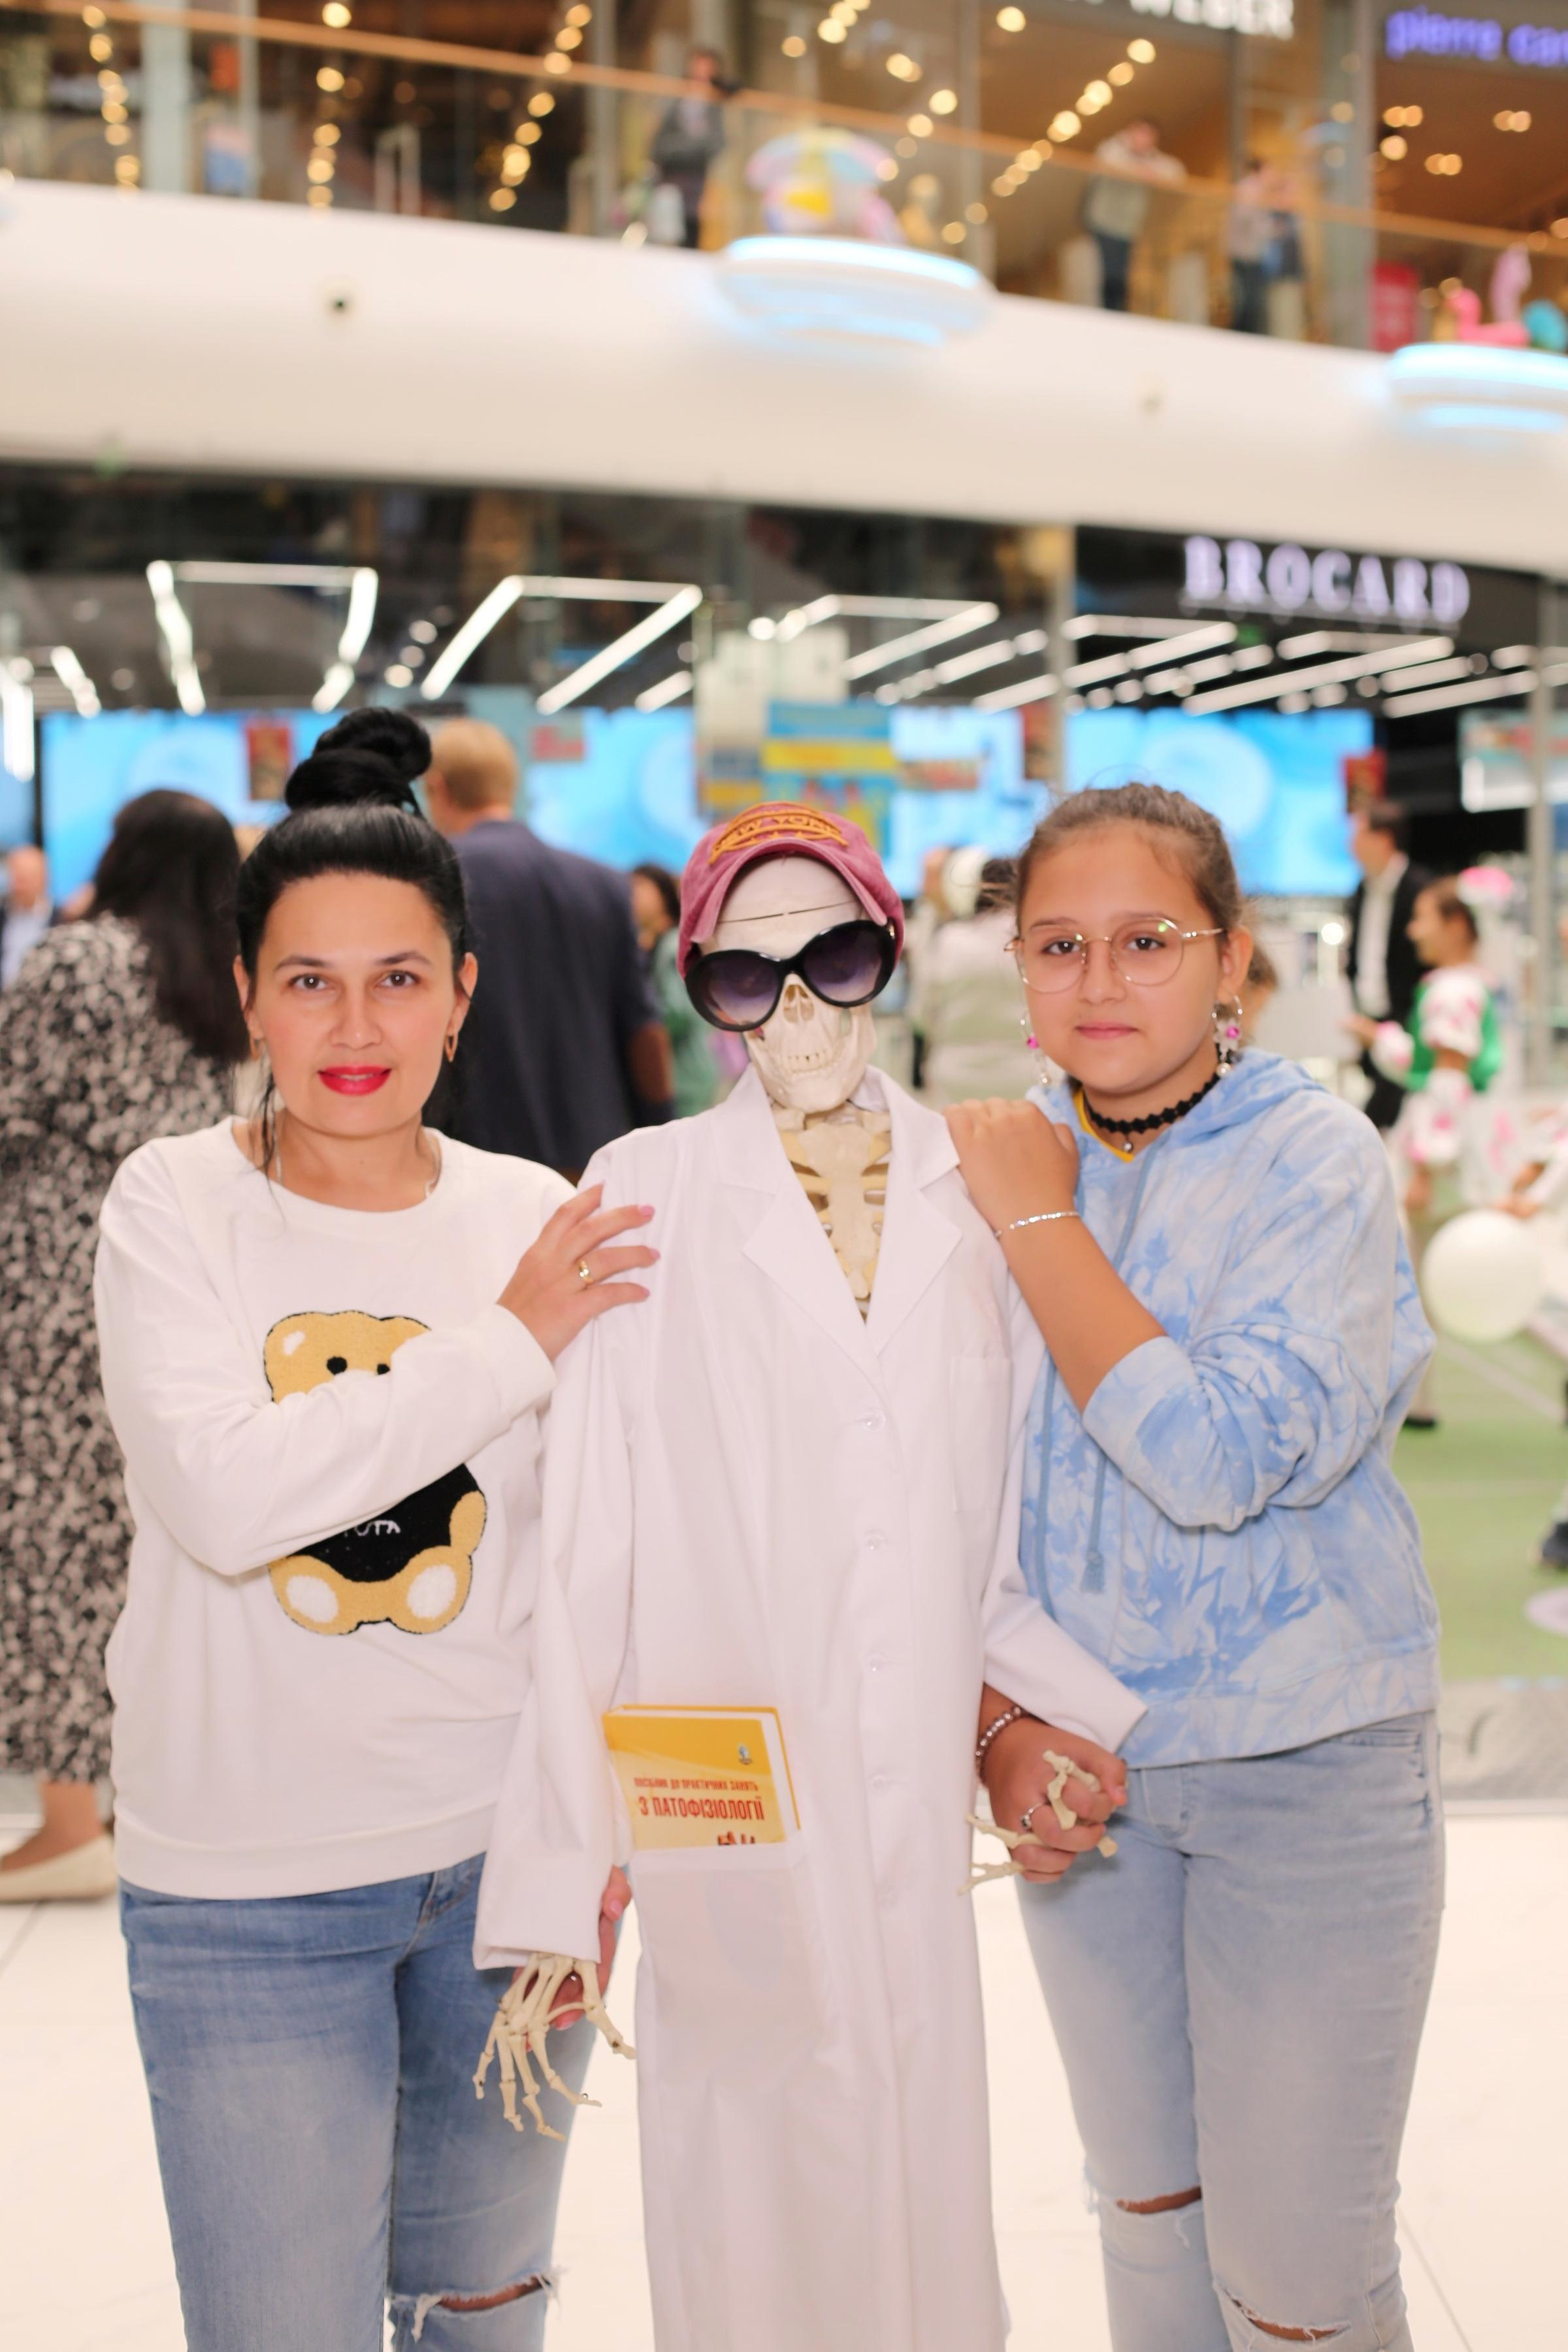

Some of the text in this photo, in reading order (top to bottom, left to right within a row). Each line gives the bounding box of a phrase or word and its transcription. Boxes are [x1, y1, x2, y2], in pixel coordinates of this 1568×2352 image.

[1386, 4, 1502, 61] pierre
[1184, 535, 1470, 624] BROCARD
[653, 1796, 764, 1820] ПАТОФІЗІОЛОГІЇ
